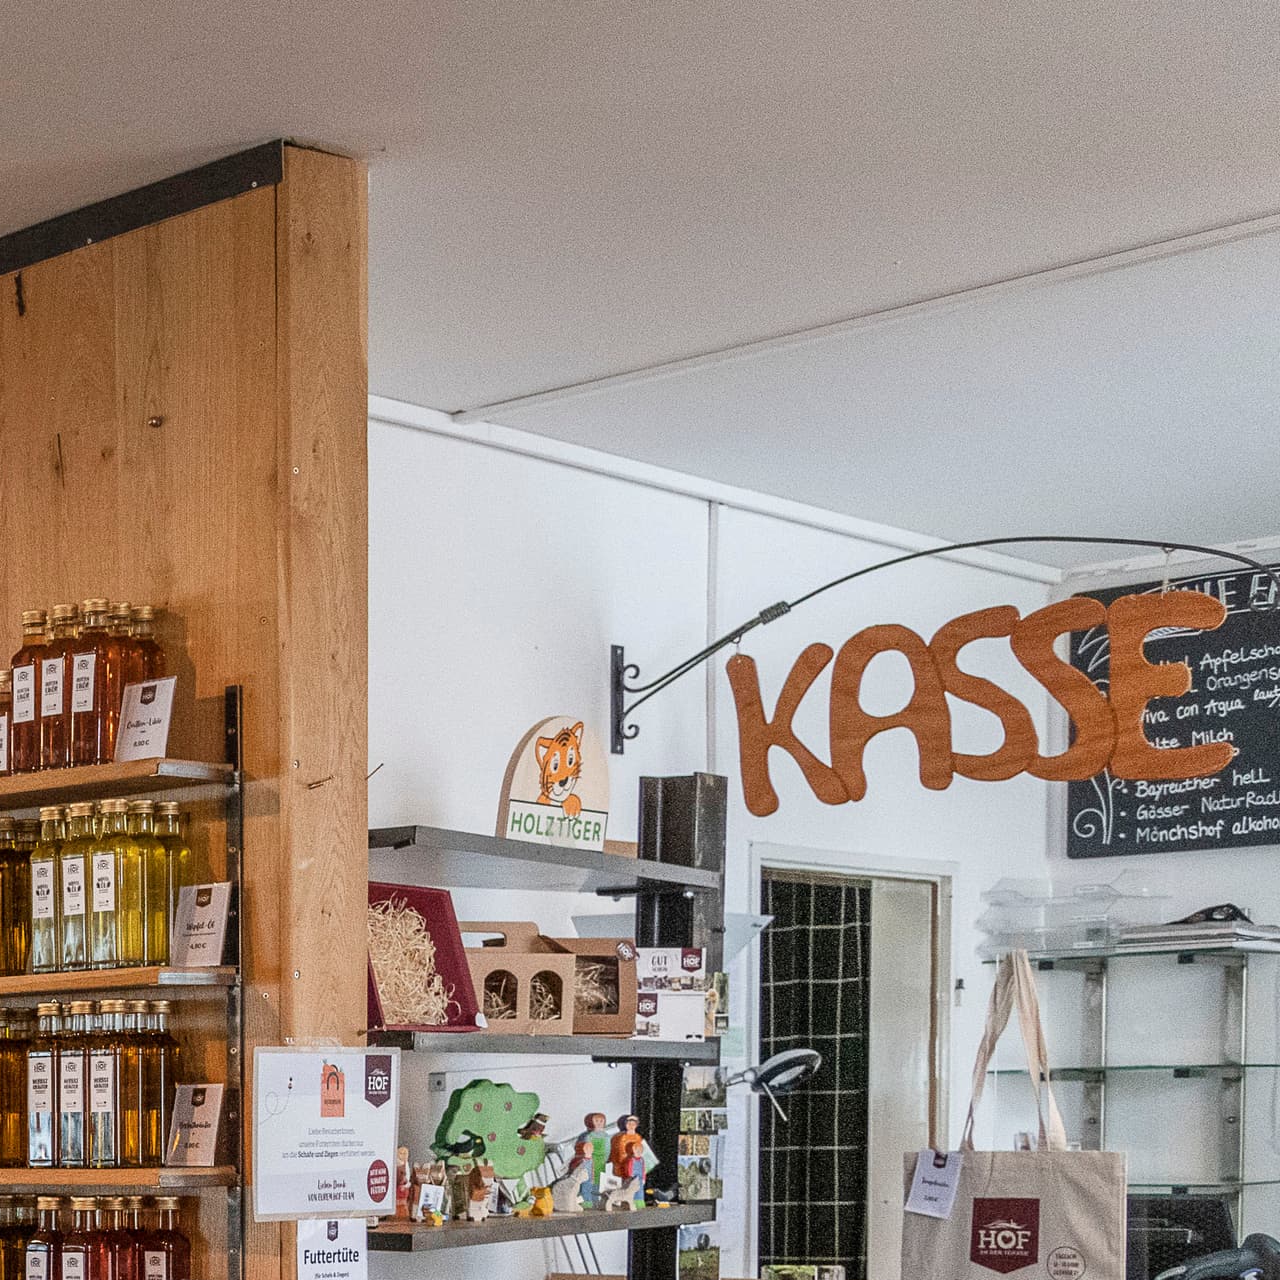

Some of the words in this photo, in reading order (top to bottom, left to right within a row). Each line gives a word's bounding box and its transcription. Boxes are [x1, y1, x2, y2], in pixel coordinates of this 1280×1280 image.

[726, 591, 1235, 817] KASSE
[1176, 703, 1199, 720] con
[1204, 698, 1246, 717] Agua
[1134, 777, 1220, 801] Bayreuther
[510, 811, 601, 842] HOLZTIGER
[1136, 819, 1225, 843] Mönchshof
[368, 1076, 389, 1091] HOF
[978, 1229, 1032, 1250] HOF
[303, 1248, 360, 1265] Futtertüte
